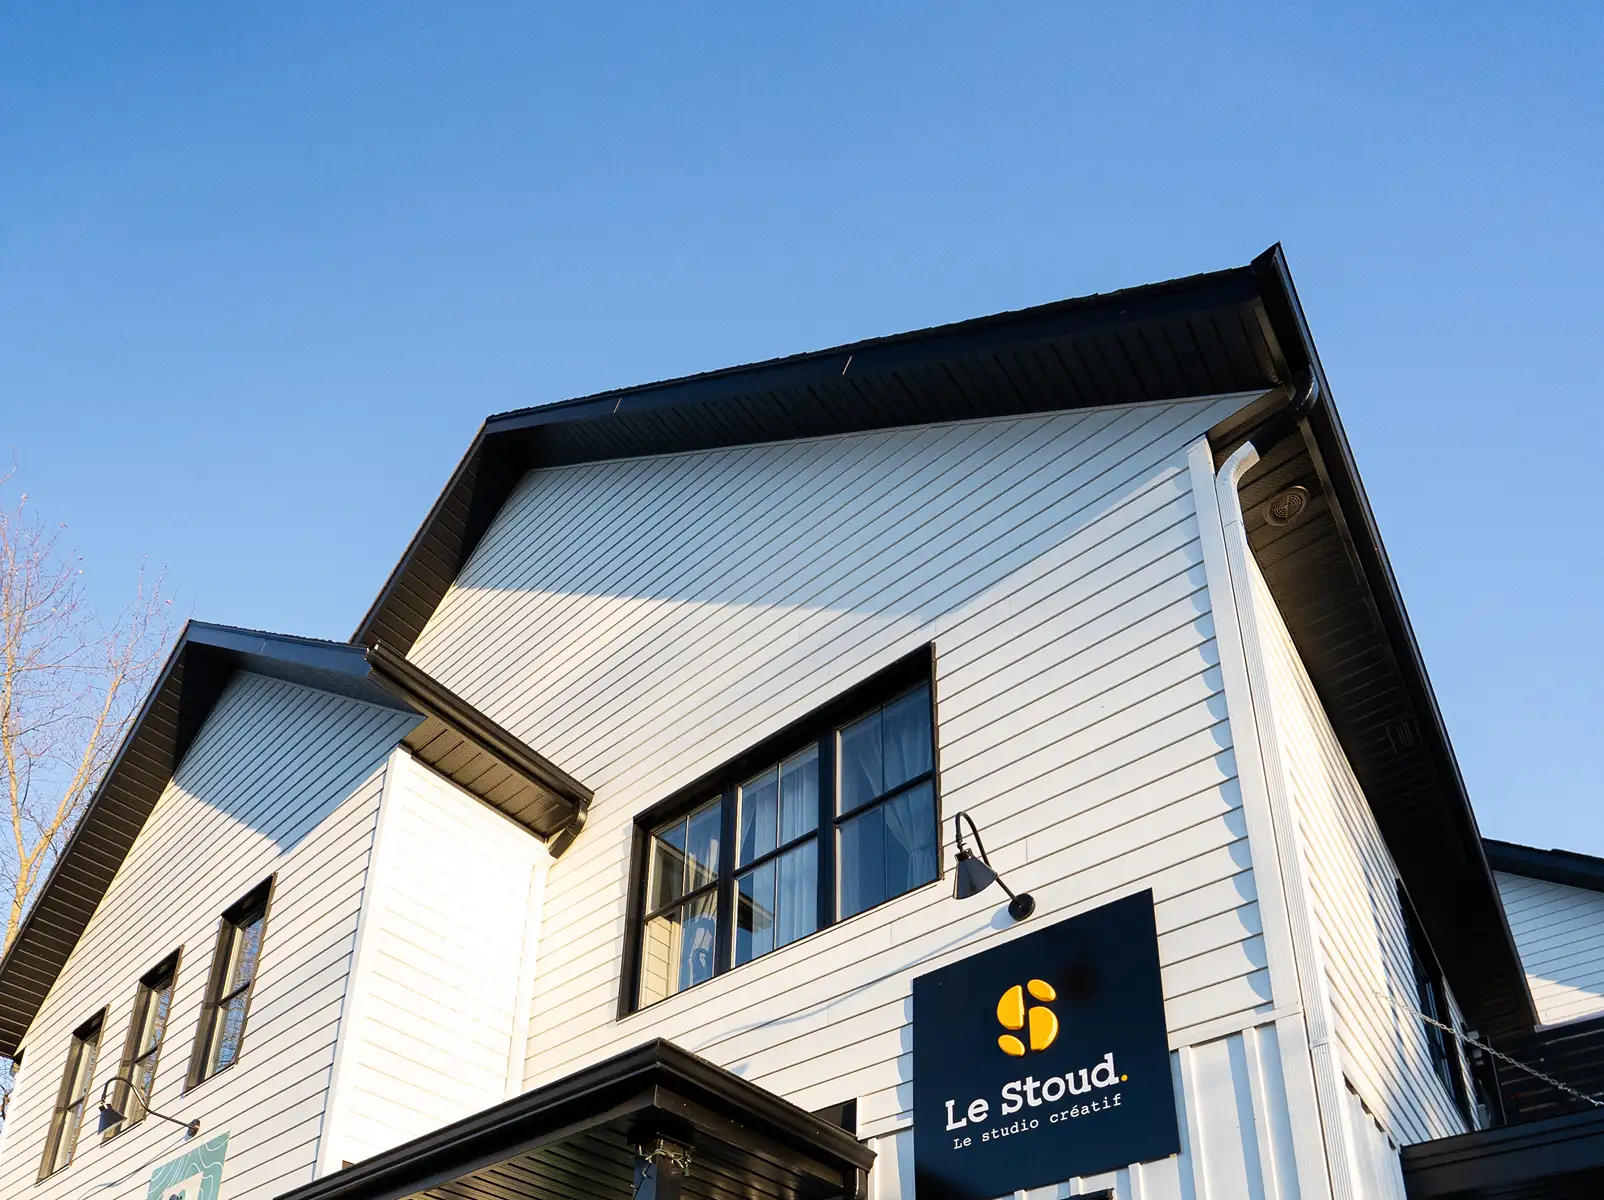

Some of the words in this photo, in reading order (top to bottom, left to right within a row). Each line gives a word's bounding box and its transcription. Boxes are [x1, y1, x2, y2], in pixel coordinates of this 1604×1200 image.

[945, 1099, 989, 1131] Le
[1001, 1052, 1128, 1116] Stoud.
[953, 1137, 972, 1149] Le
[982, 1118, 1039, 1142] studio
[1049, 1093, 1122, 1124] créatif
